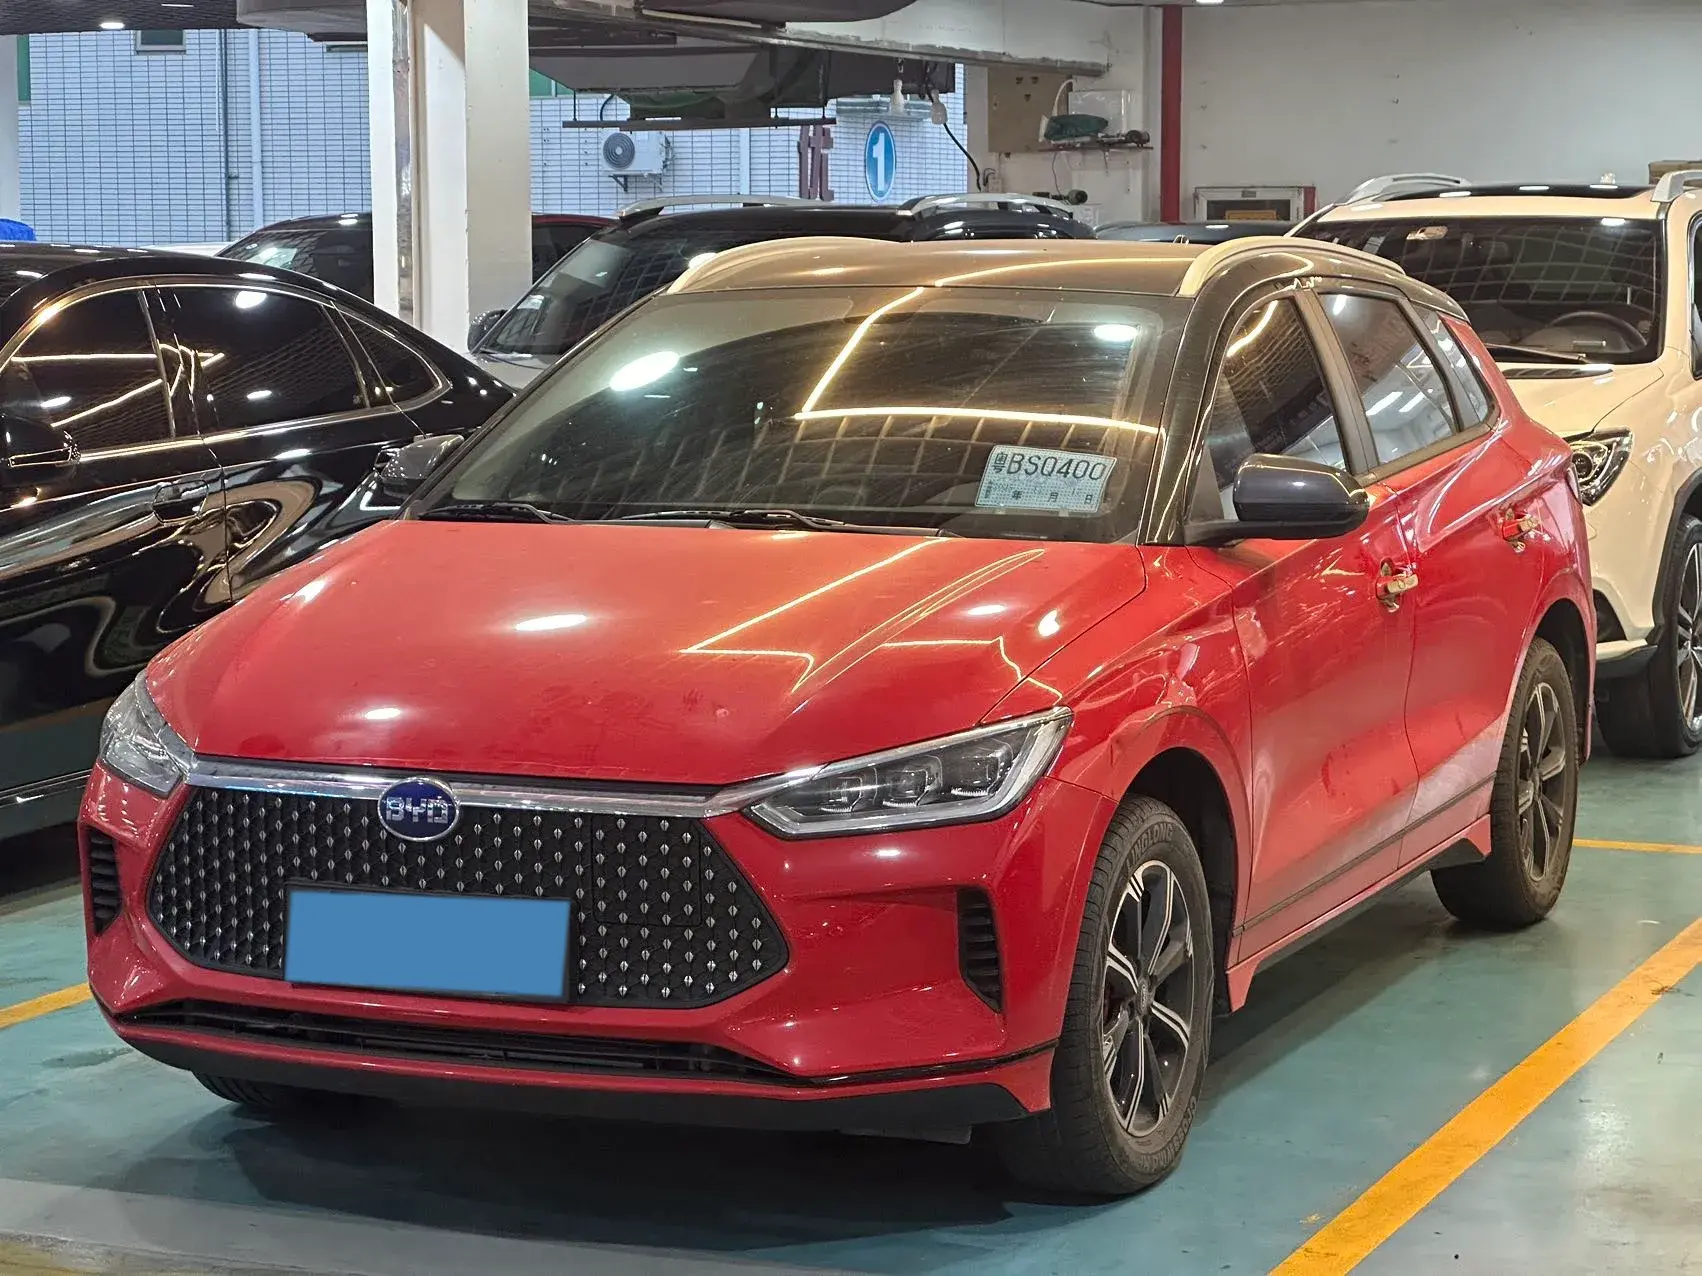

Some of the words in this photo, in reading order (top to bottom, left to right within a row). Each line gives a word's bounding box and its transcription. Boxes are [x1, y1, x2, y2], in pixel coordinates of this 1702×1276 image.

[872, 132, 885, 191] 1
[386, 796, 449, 823] BYD
[1126, 822, 1173, 867] LINGLONG
